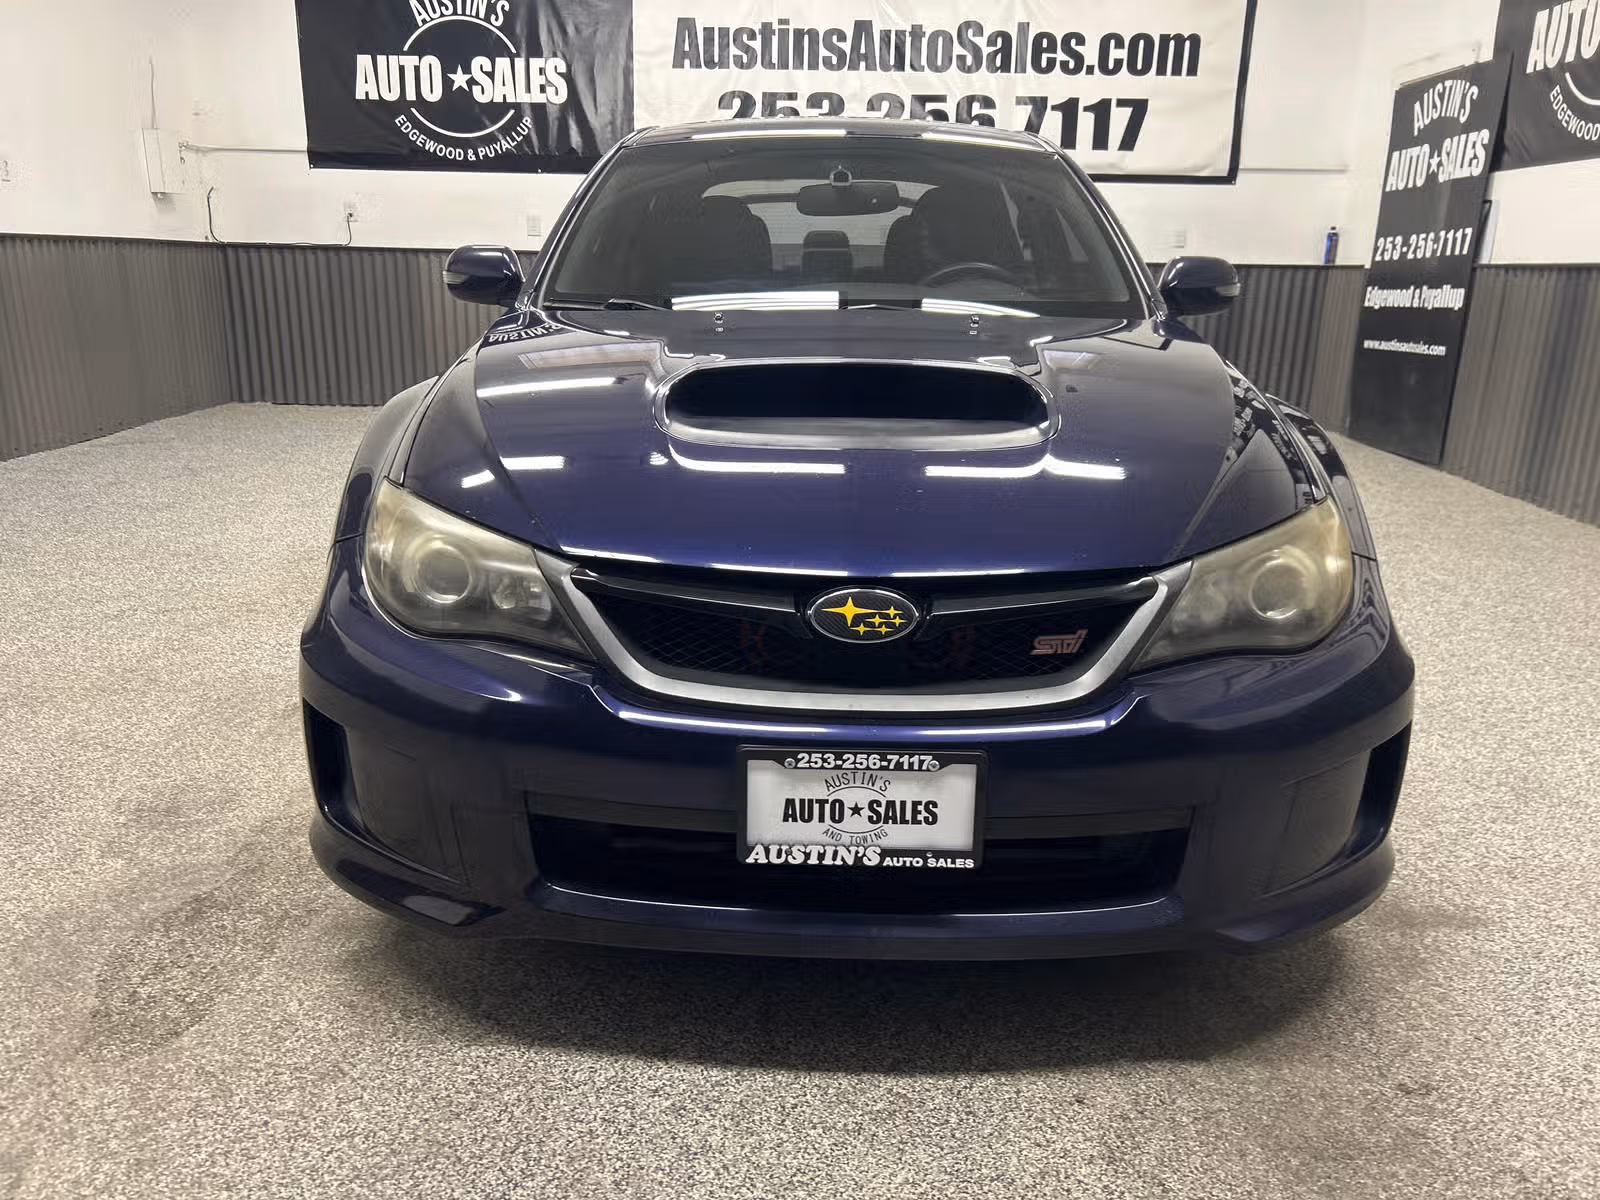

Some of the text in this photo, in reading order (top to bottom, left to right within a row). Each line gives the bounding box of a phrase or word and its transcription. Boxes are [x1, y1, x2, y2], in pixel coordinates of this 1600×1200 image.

[672, 17, 1201, 77] AustinsAutoSales.com
[355, 54, 569, 105] AUTO SALES
[1413, 79, 1479, 136] AUSTIN'S
[1550, 85, 1600, 141] EDGEWOOD
[394, 114, 534, 161] EDGEWOOD & PUYALLUP
[1385, 129, 1490, 192] AUTO SALES
[1363, 285, 1465, 310] Edgewood & Puyallup
[797, 753, 932, 770] 253-256-7117
[824, 771, 891, 792] AUSTIN'S
[782, 798, 938, 826] AUTO SALES
[822, 828, 888, 845] AND TOWING
[746, 845, 975, 868] AUSTIN'S AUTO SALES
